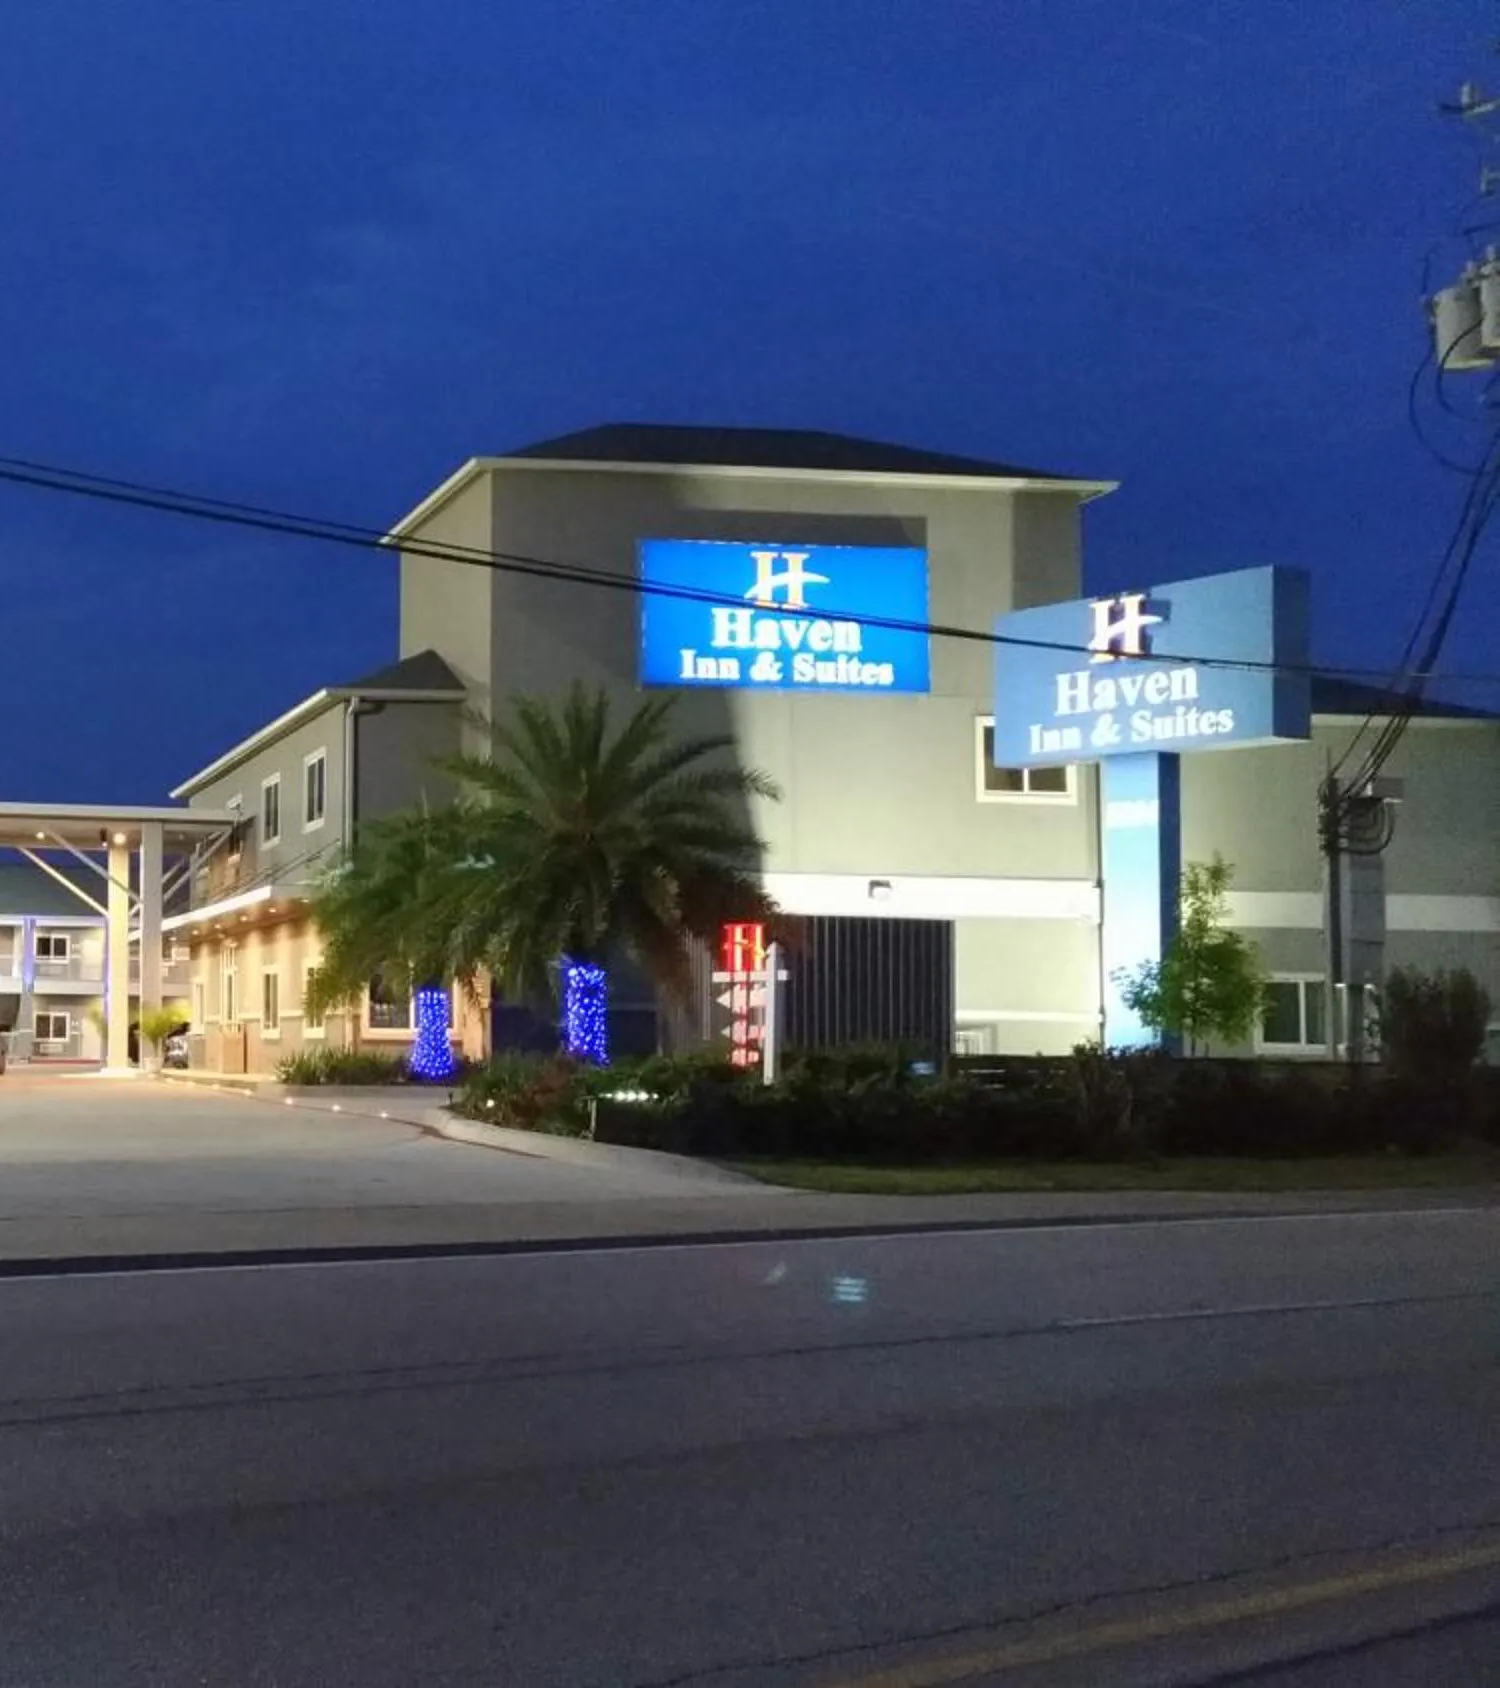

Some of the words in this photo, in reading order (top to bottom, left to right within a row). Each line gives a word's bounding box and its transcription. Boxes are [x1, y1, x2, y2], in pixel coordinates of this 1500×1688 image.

[710, 607, 863, 652] Haven
[679, 649, 741, 680] Inn
[750, 651, 784, 682] &
[793, 652, 895, 685] Suites
[1054, 667, 1199, 717] Haven
[1029, 723, 1082, 755] Inn
[1090, 713, 1122, 748] &
[1130, 706, 1235, 742] Suites
